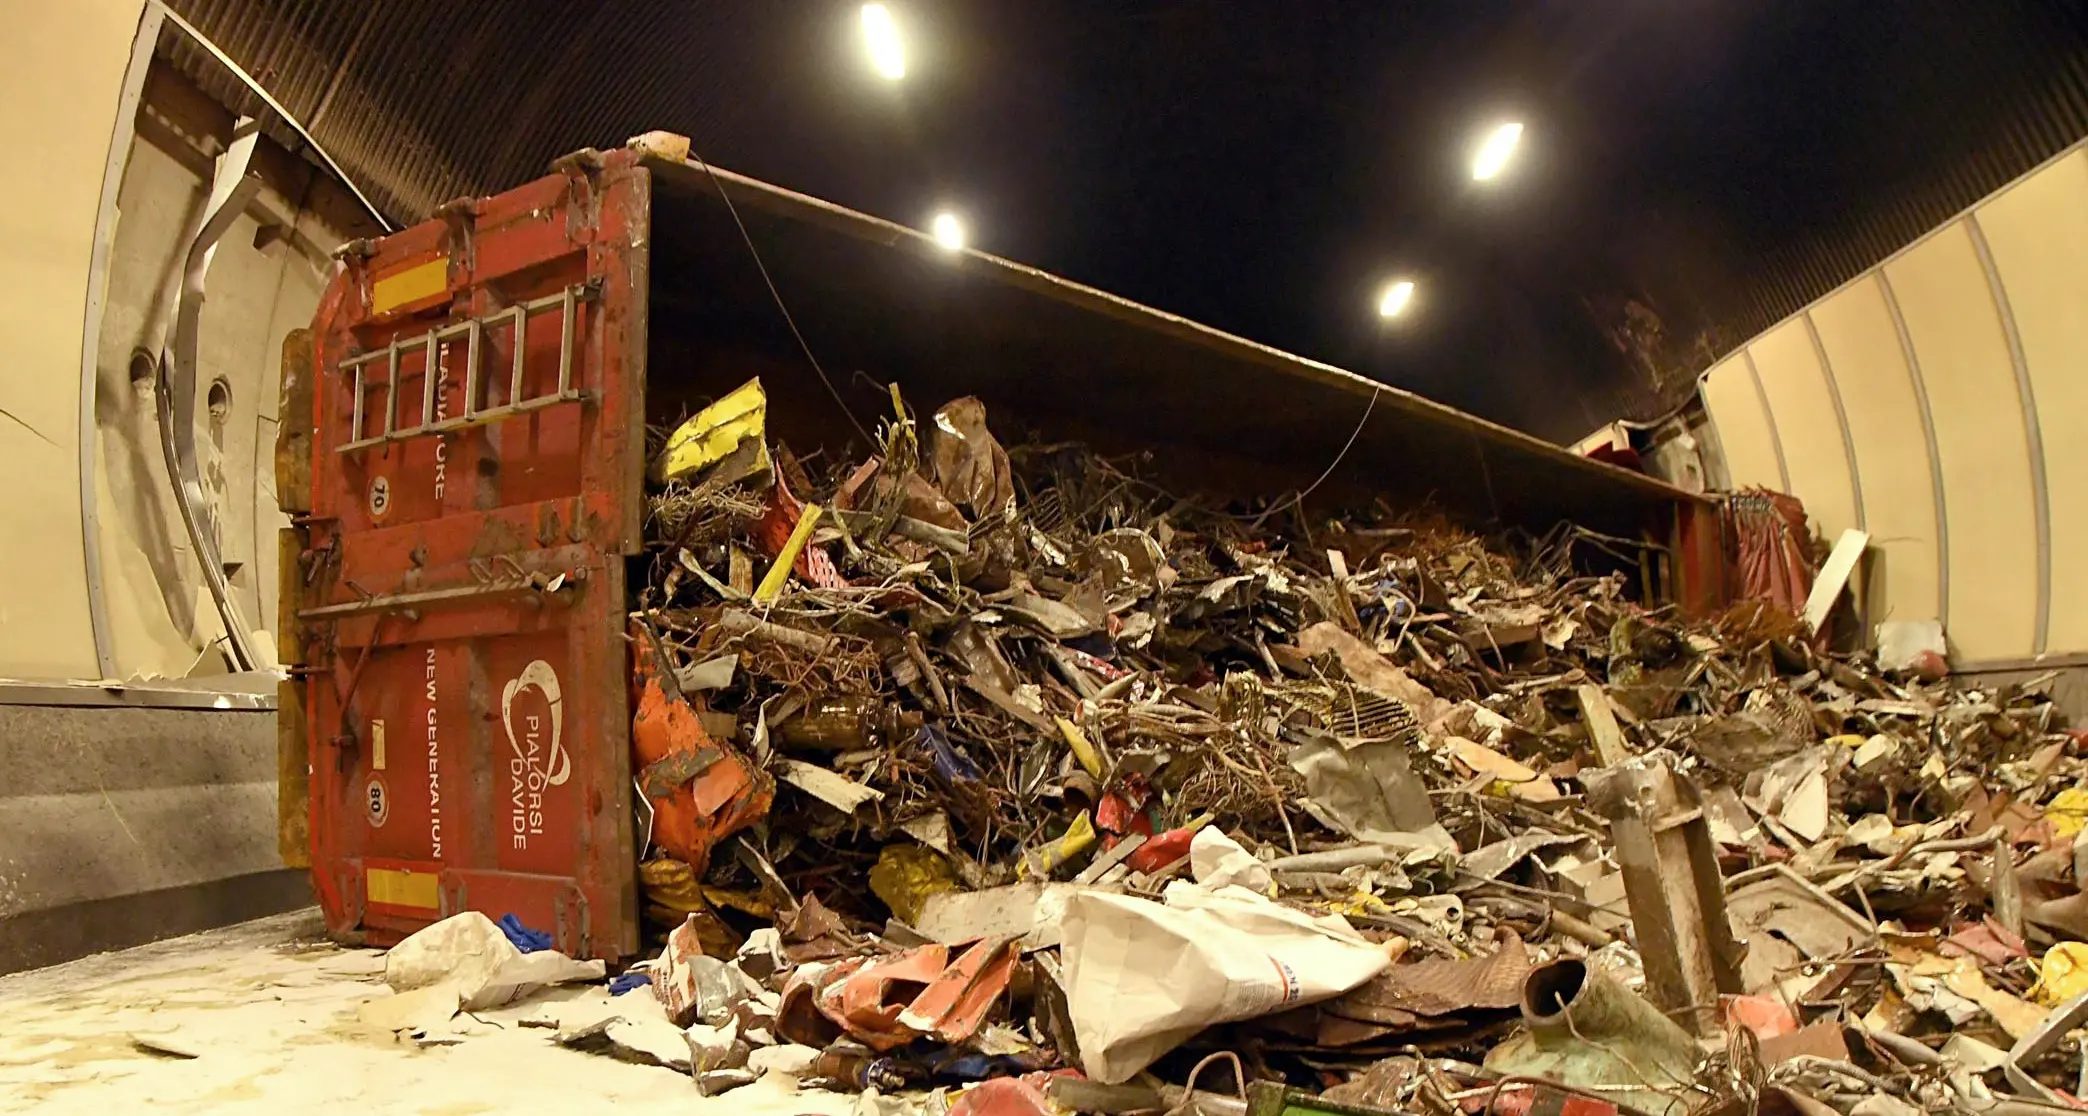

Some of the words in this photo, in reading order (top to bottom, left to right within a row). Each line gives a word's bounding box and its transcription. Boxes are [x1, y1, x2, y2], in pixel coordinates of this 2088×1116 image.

[374, 484, 386, 508] 70
[426, 648, 437, 701] NEW
[370, 787, 382, 813] 80
[526, 715, 543, 834] PIALORSI
[511, 759, 526, 850] DAVIDE
